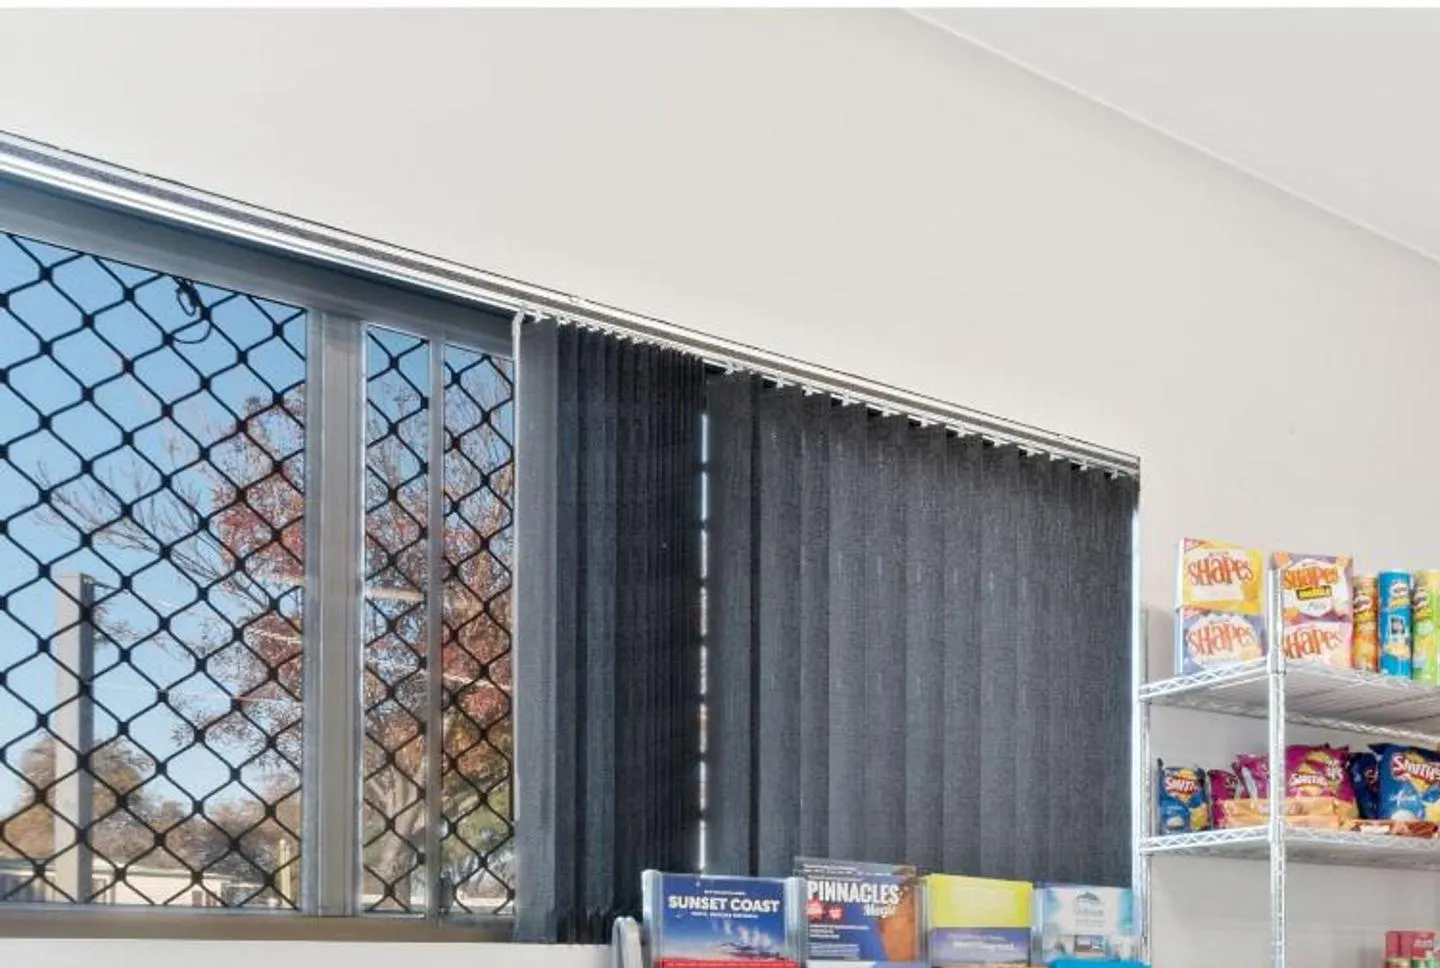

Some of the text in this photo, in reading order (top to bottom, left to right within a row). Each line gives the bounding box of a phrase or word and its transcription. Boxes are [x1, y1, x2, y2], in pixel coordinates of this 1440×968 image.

[807, 880, 901, 905] PINNACLES
[668, 895, 781, 913] SUNSET COAST
